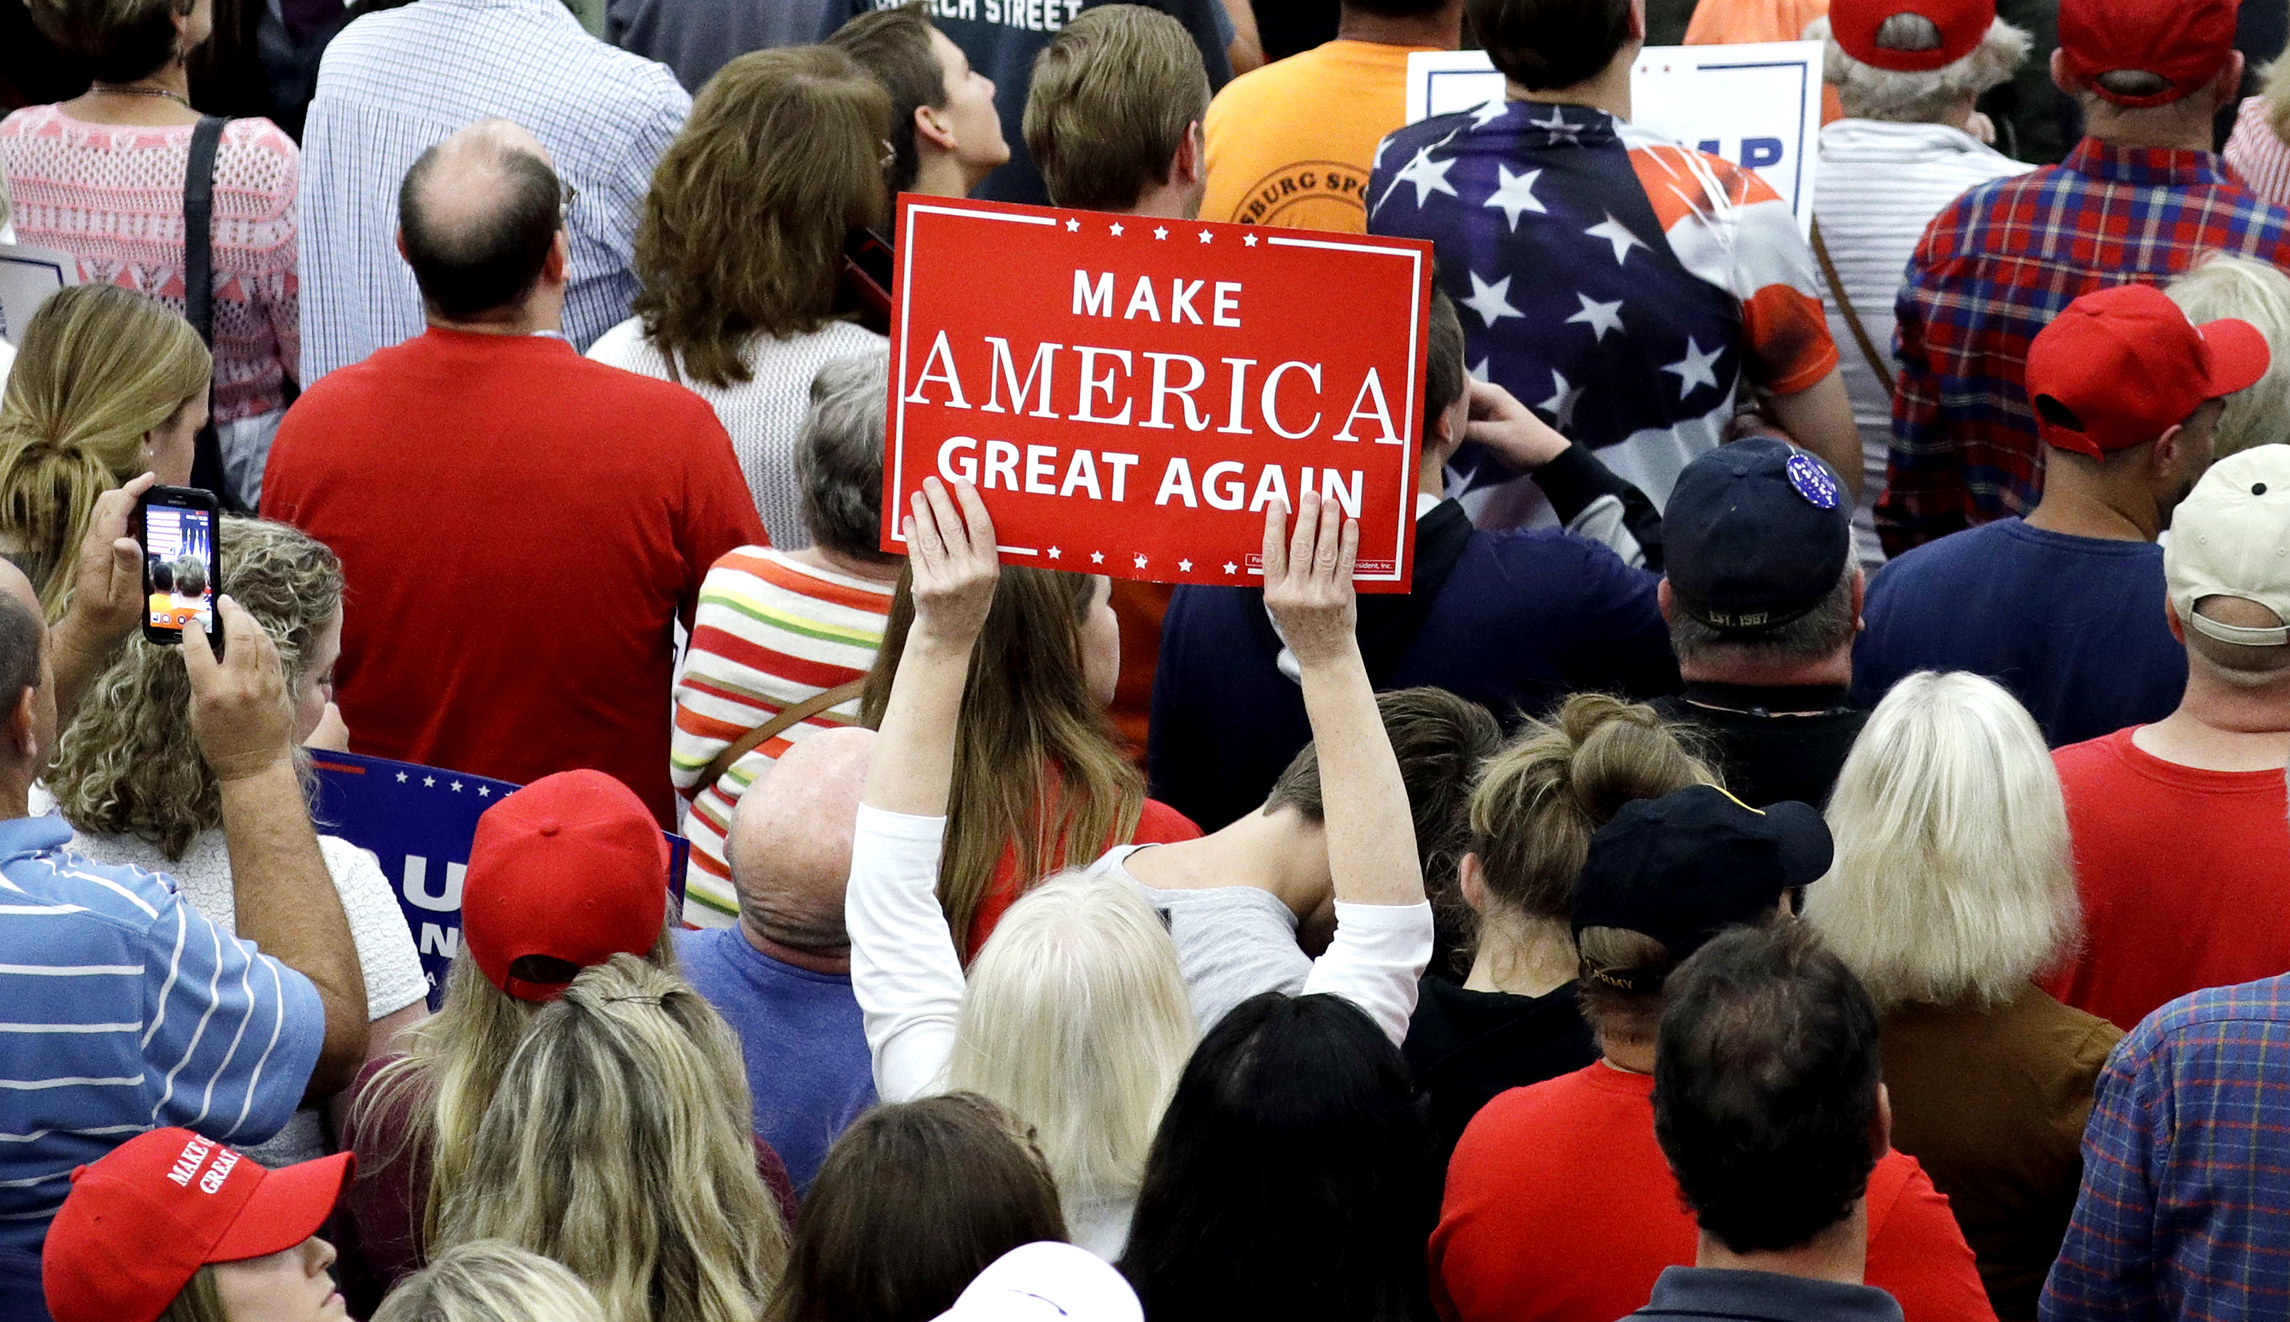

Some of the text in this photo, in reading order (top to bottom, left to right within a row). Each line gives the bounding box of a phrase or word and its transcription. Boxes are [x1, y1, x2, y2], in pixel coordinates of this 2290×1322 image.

[984, 0, 1083, 31] STREET
[1072, 269, 1242, 328] MAKE
[904, 329, 1404, 445] AMERICA
[937, 435, 1364, 519] GREAT AGAIN
[1381, 562, 1393, 570] Inc.
[1739, 611, 1769, 627] 1987
[166, 1140, 210, 1188] MAKE
